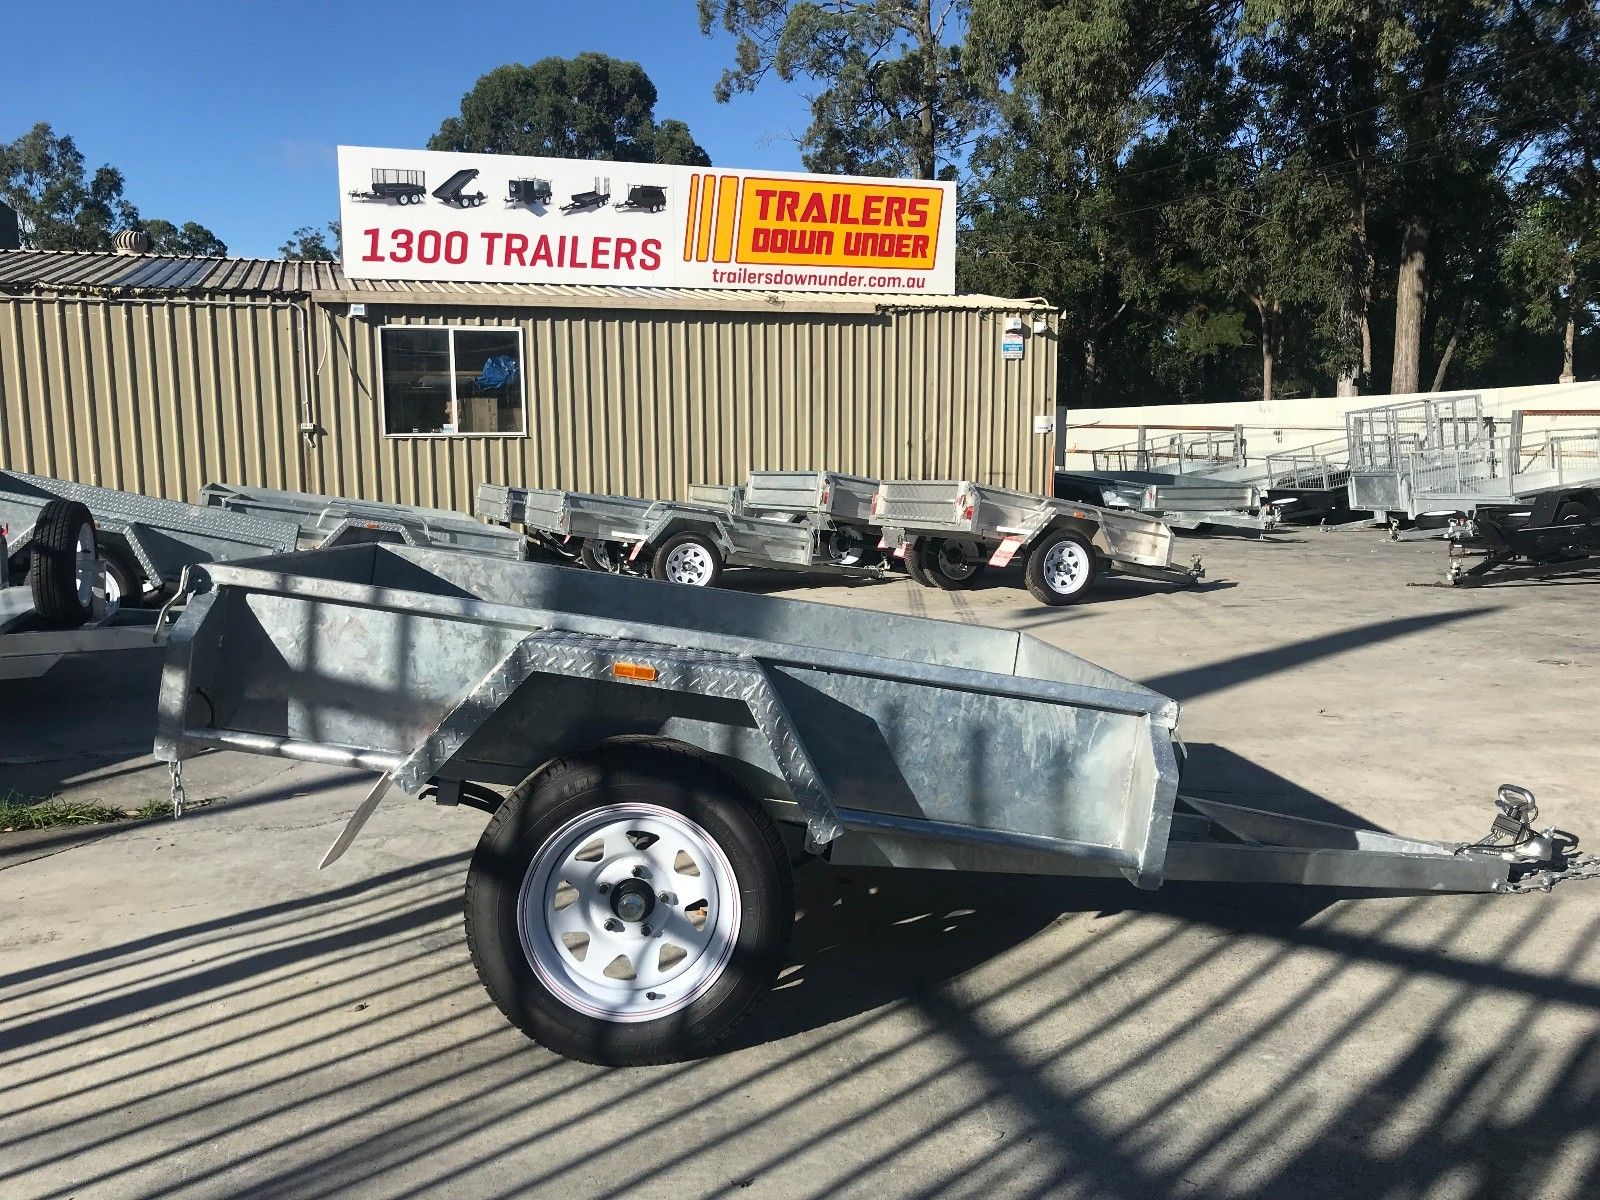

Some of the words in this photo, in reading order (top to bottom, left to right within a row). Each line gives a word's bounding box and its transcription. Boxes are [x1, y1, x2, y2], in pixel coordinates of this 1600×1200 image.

[755, 189, 930, 228] TRAILERS
[361, 227, 469, 265] 1300
[480, 232, 663, 271] TRAILERS
[751, 227, 835, 256] DOWN
[843, 231, 930, 259] UNDER
[712, 268, 926, 289] trailersdownunder.com.au
